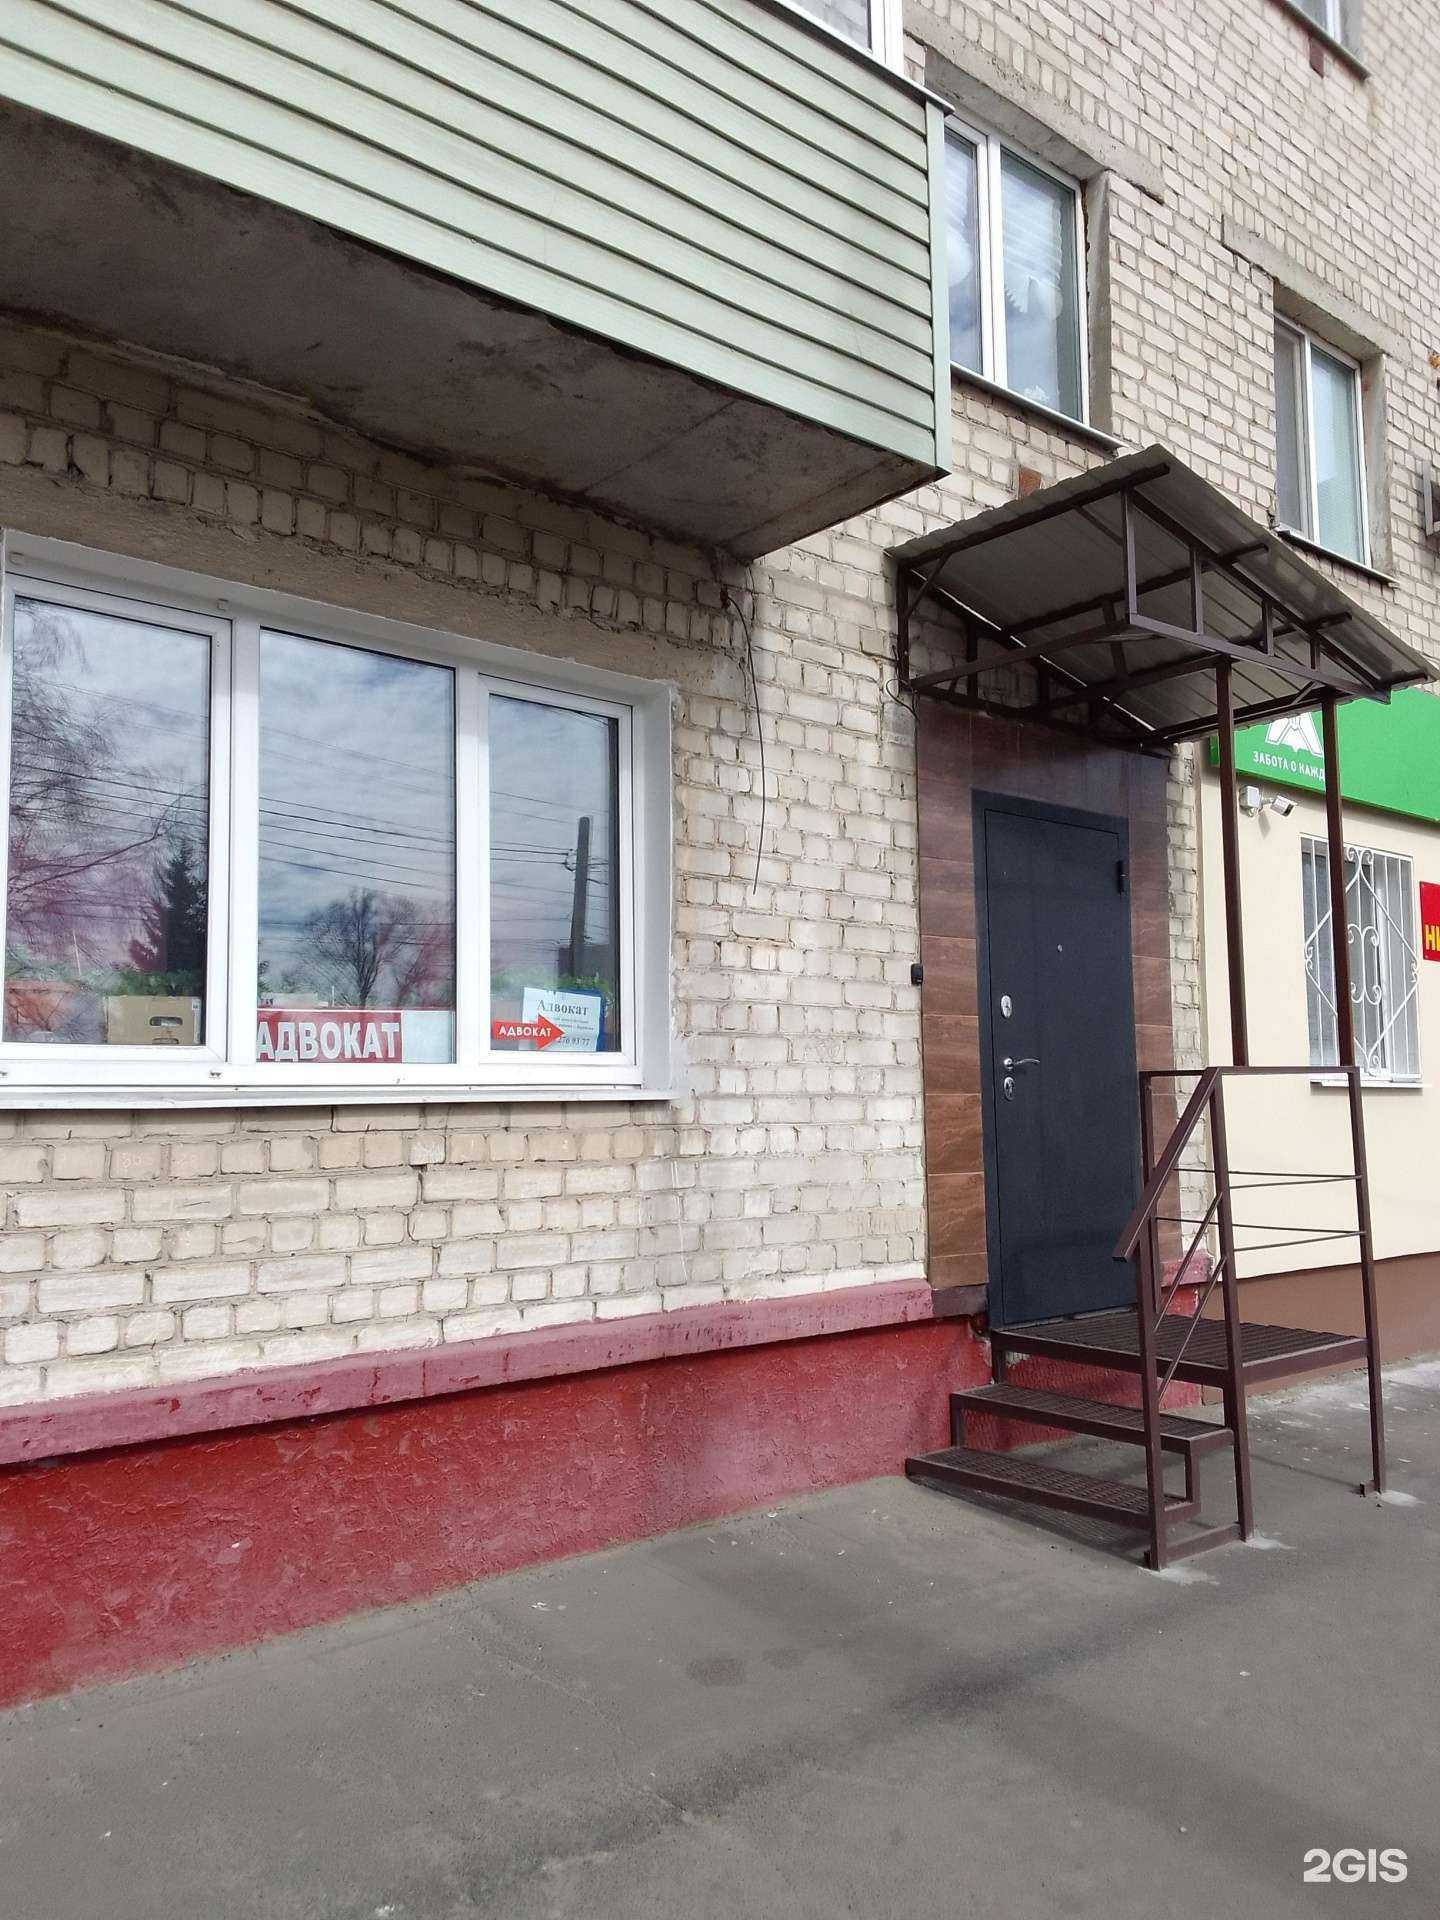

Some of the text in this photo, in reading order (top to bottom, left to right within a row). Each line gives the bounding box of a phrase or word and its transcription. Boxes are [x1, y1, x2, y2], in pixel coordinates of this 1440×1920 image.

[1253, 750, 1325, 781] ЗАБОТА О КАЖД
[538, 999, 590, 1016] Адвокат
[257, 1021, 399, 1062] АДВОКАТ
[499, 1025, 552, 1037] АДВОКАТ
